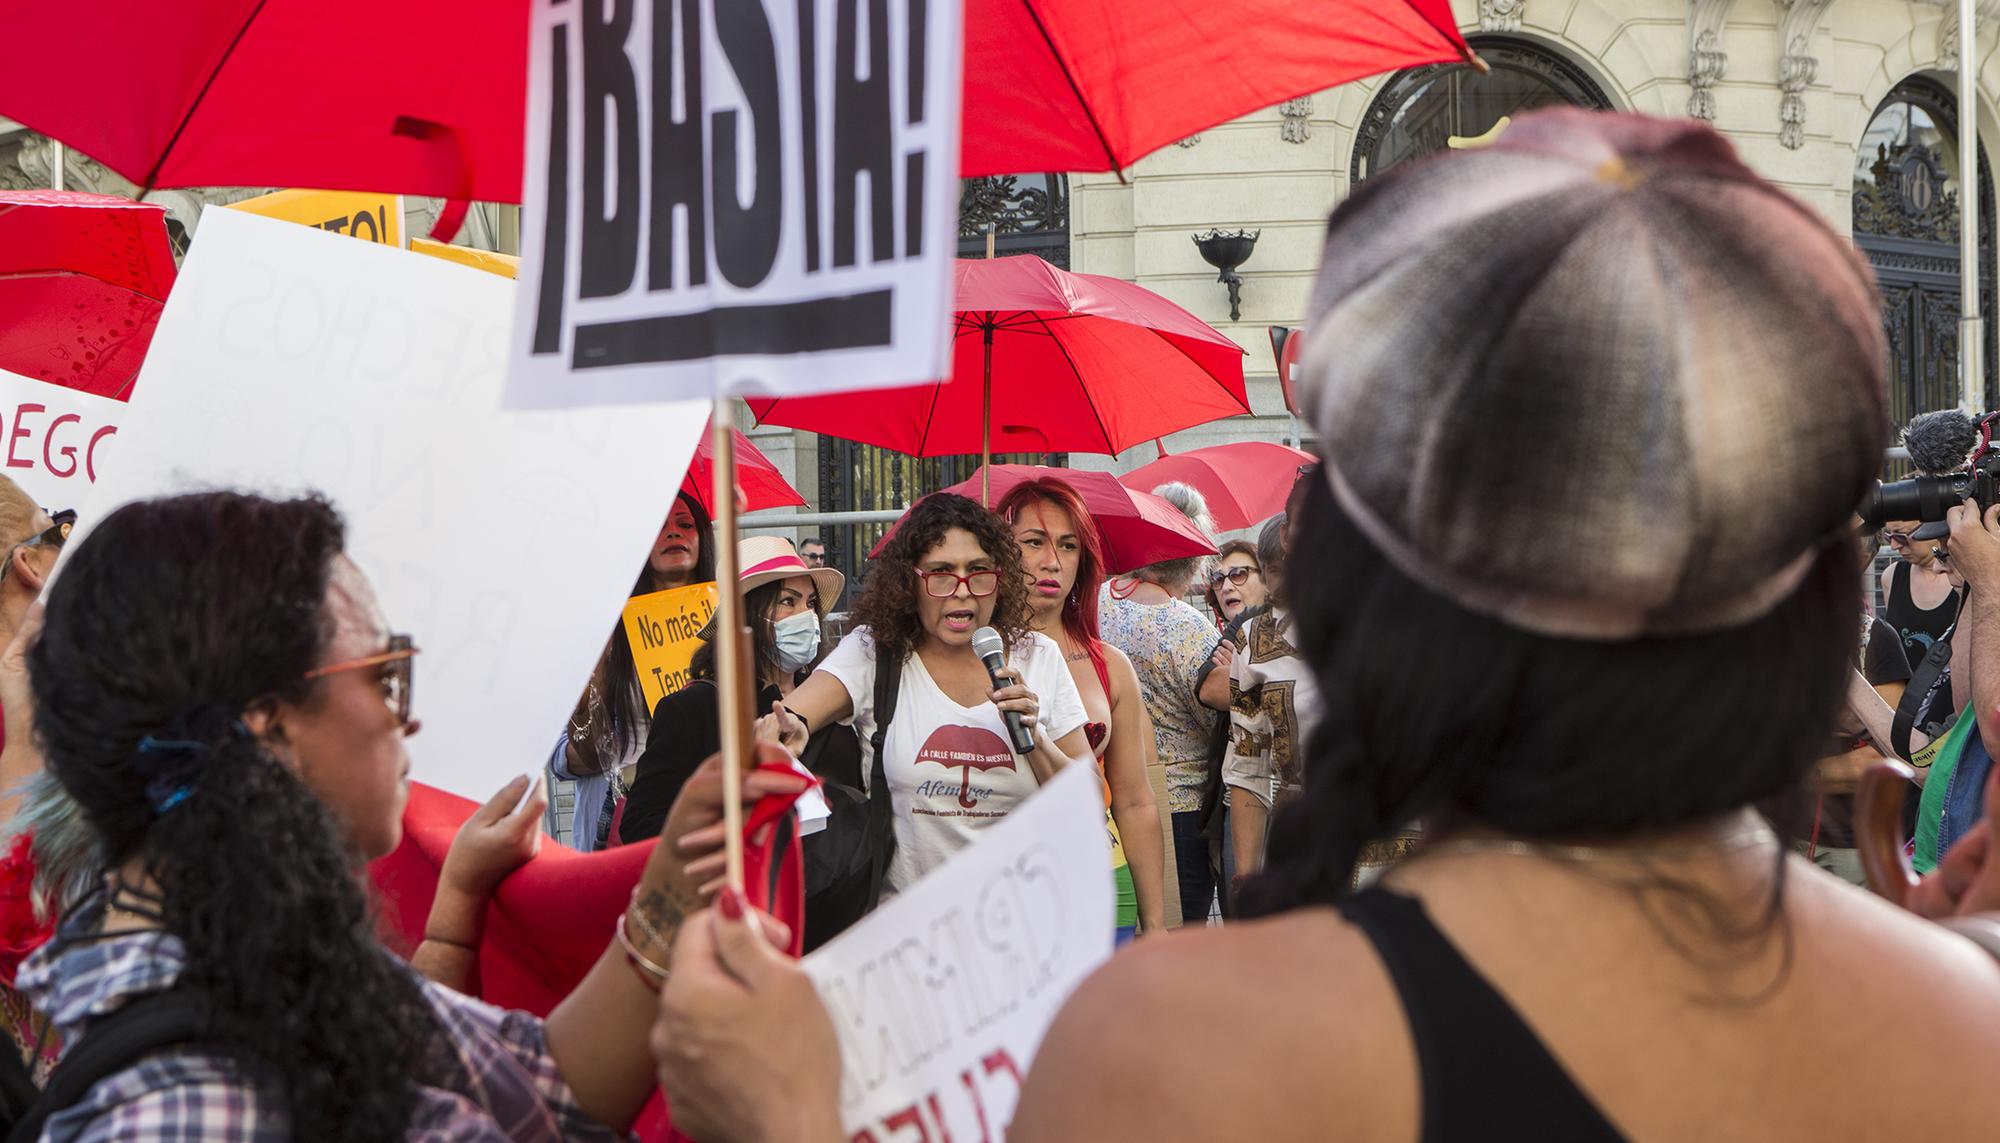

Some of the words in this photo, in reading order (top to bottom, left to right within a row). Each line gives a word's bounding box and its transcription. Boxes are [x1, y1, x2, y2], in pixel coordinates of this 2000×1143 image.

[637, 614, 664, 650] No
[665, 605, 702, 644] más
[920, 749, 929, 758] LA
[930, 750, 948, 760] CALLE
[976, 753, 985, 762] ES
